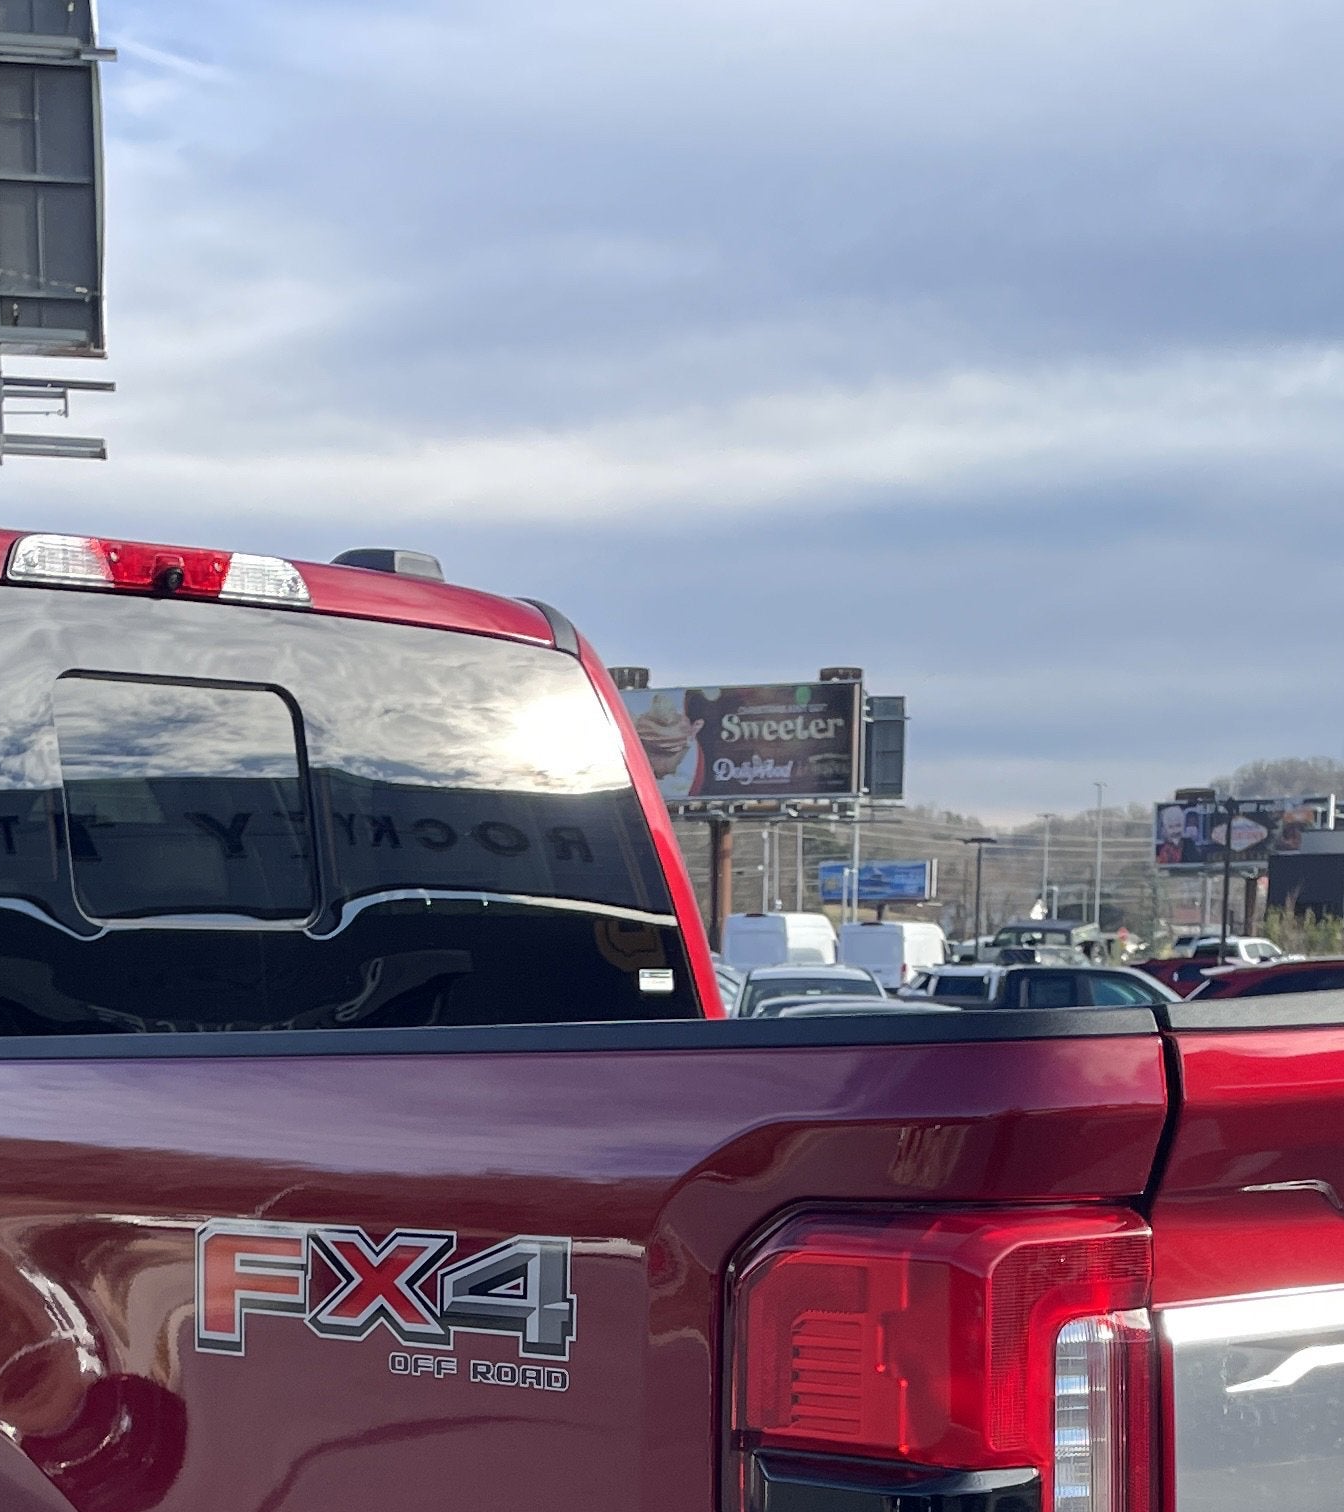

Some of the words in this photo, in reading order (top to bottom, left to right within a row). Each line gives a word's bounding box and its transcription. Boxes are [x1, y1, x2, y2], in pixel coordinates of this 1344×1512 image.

[720, 713, 845, 742] Sweeter
[195, 1217, 577, 1362] FX4
[389, 1352, 457, 1379] OFF
[469, 1360, 569, 1392] ROAD
